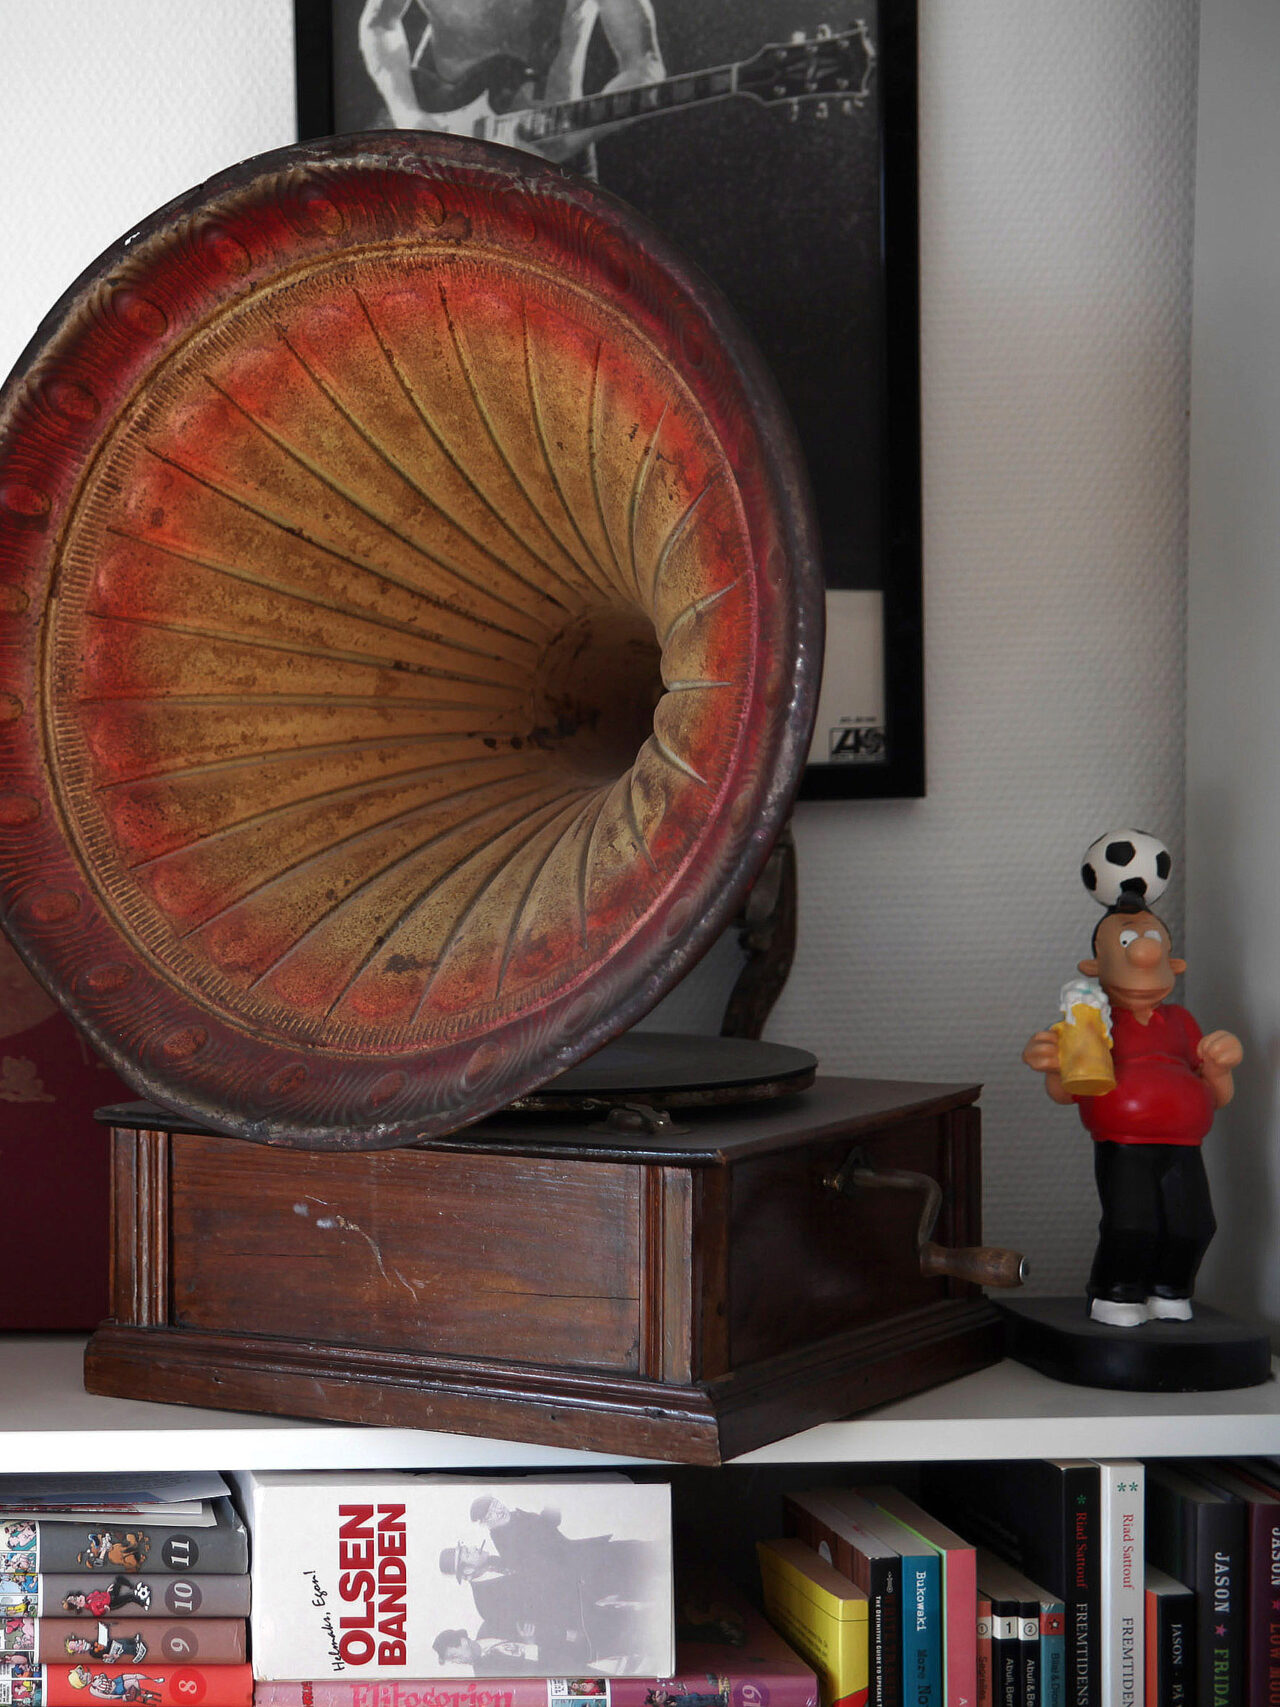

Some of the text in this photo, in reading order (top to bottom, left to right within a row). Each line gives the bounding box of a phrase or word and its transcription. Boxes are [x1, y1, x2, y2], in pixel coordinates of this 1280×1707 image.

[1122, 1514, 1134, 1542] Riad
[171, 1540, 191, 1567] 11
[1122, 1544, 1135, 1590] Sattouf
[174, 1582, 193, 1611] 10
[303, 1570, 328, 1607] Egon!
[338, 1504, 376, 1666] OLSEN
[377, 1503, 407, 1666] BANDEN
[915, 1571, 927, 1632] Bukowski
[1214, 1551, 1231, 1613] JASON
[1075, 1511, 1089, 1706] Riad Sattouf FREMTIDENS
[1170, 1623, 1183, 1665] JASON
[178, 1679, 199, 1695] 8
